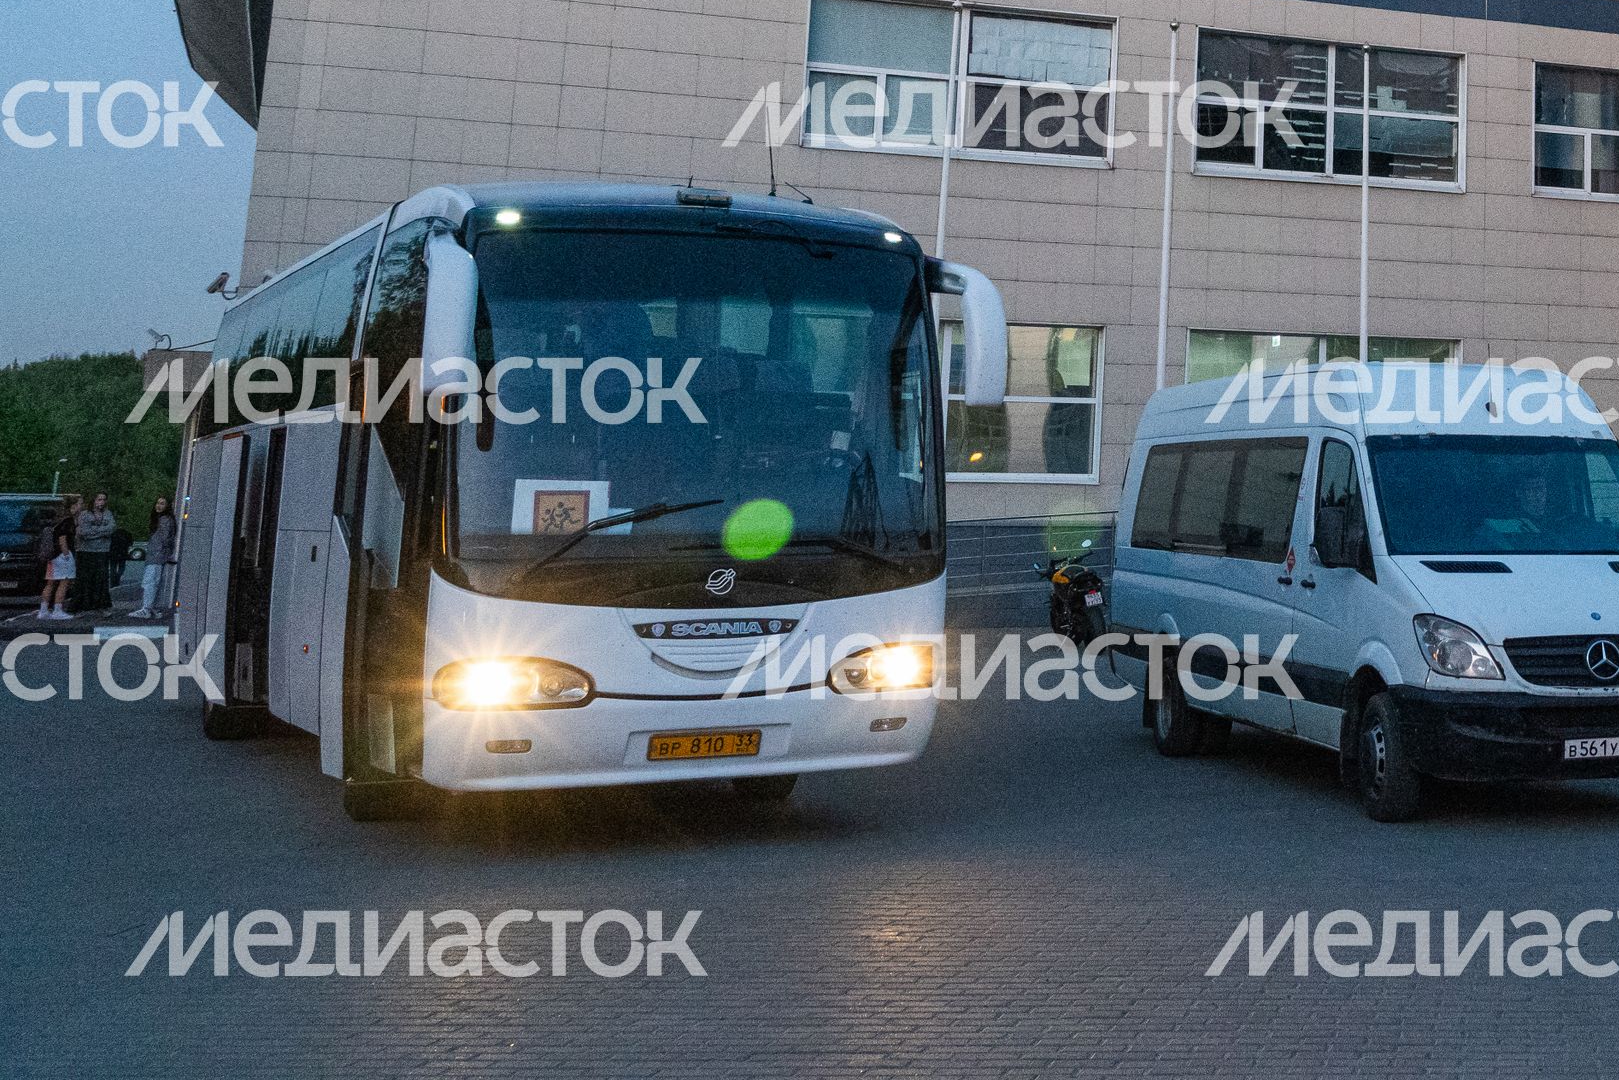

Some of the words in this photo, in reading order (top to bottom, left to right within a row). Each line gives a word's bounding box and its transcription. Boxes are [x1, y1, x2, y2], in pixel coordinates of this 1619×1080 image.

[671, 622, 763, 636] SCANIA
[690, 737, 724, 754] 810
[735, 734, 754, 747] 33
